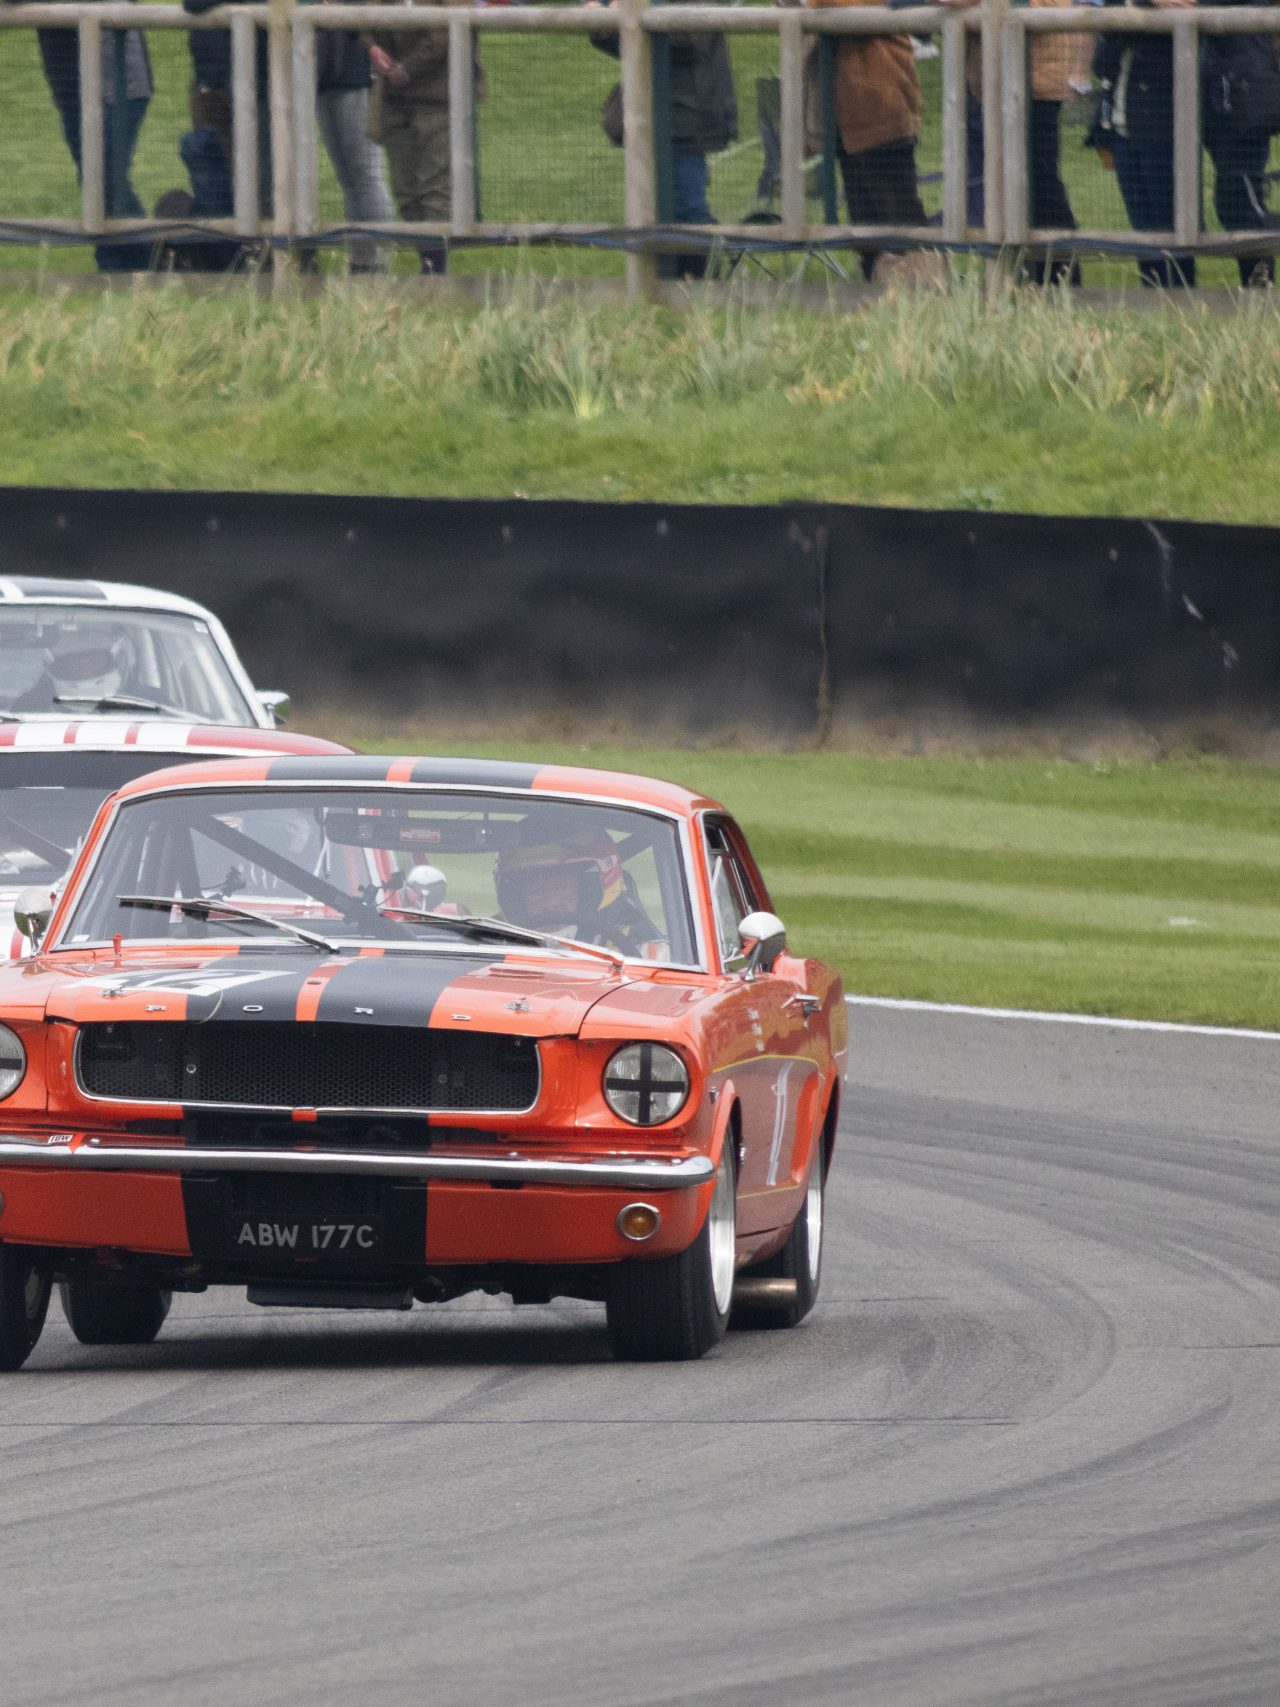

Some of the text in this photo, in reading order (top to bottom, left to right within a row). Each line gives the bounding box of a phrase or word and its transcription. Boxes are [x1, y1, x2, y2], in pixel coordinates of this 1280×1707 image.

[145, 1004, 472, 1020] FORD
[238, 1222, 374, 1249] ABW 177C
